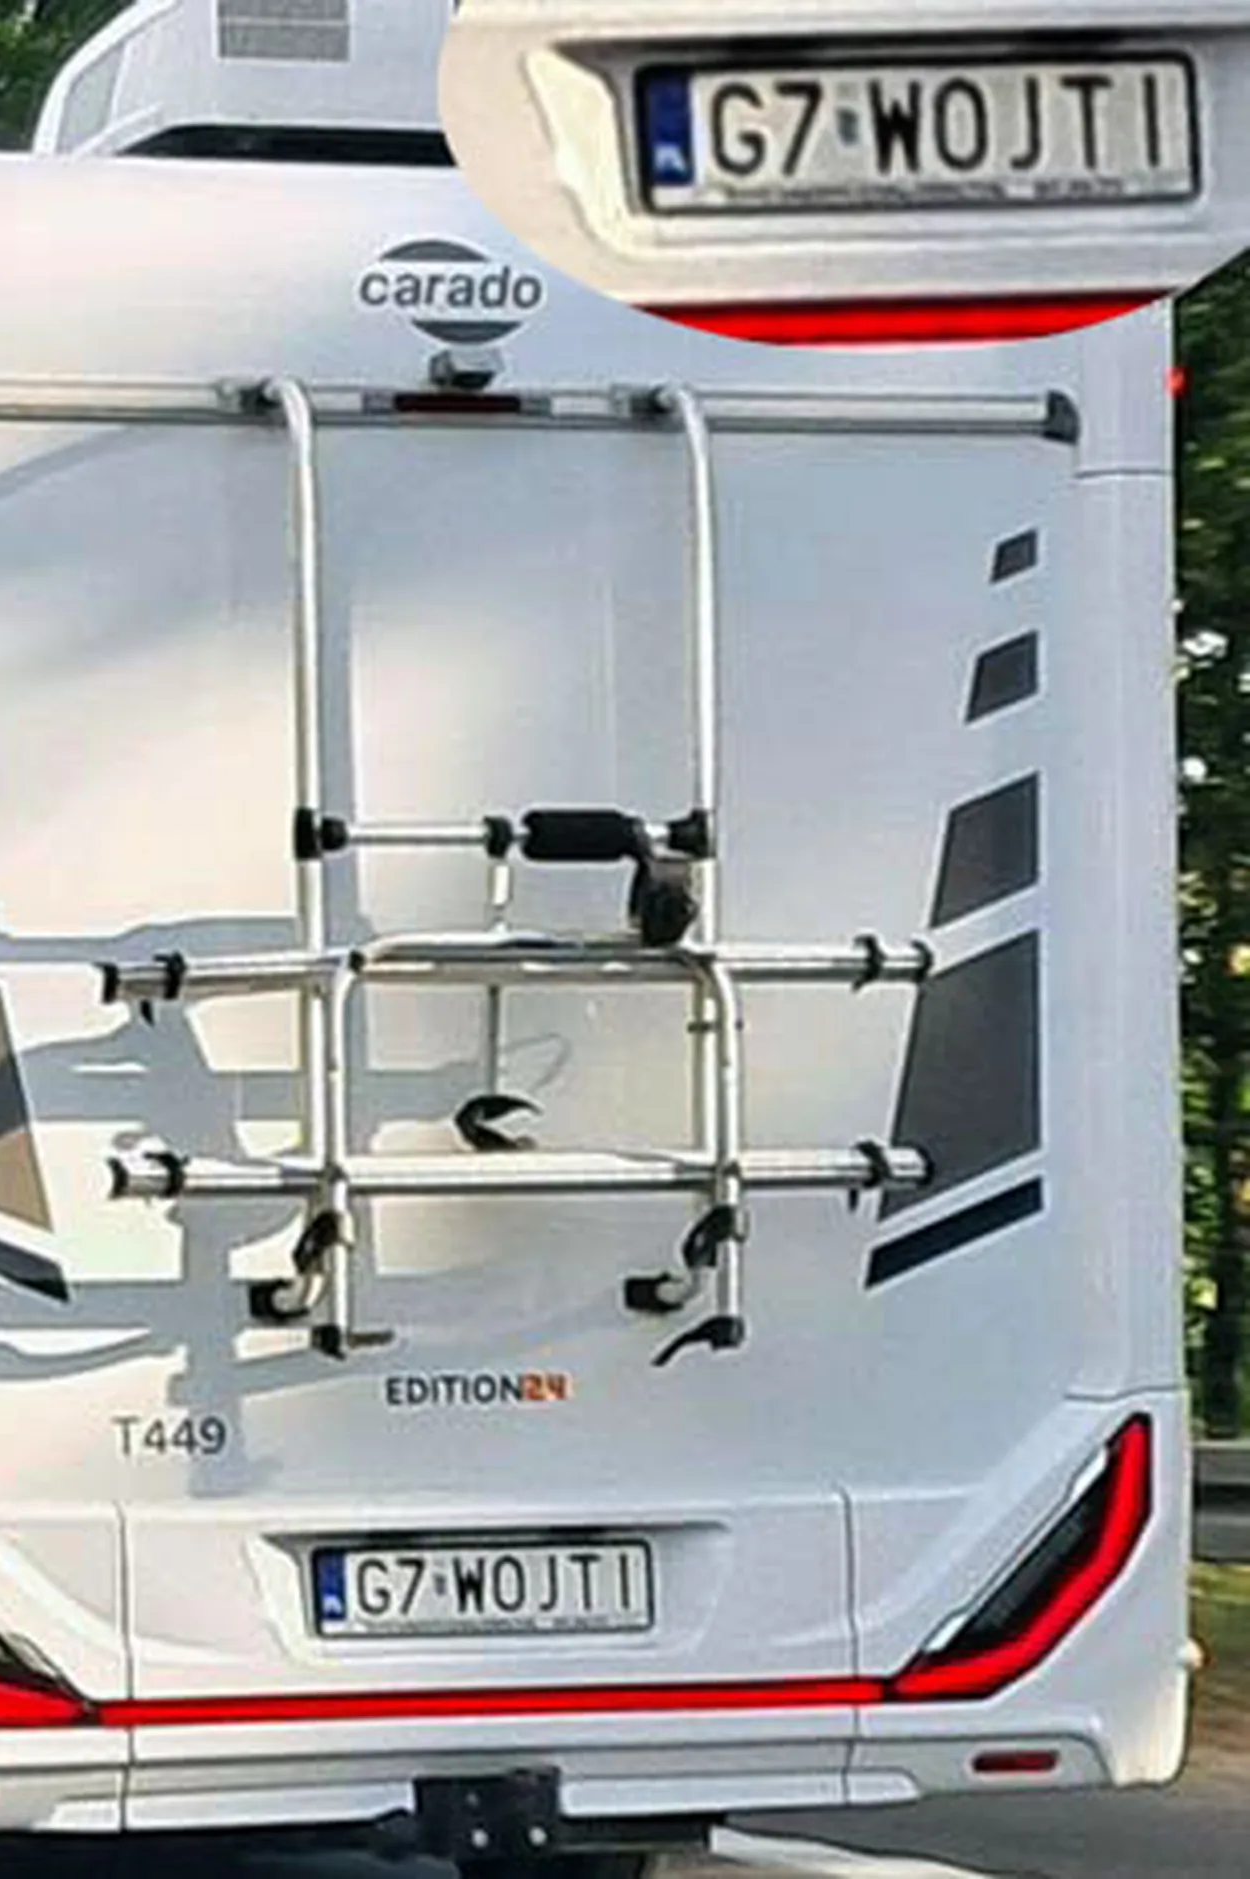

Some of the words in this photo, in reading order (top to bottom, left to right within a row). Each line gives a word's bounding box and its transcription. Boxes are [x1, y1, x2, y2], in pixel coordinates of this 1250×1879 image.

[710, 79, 823, 177] G7
[867, 73, 1160, 174] WOJTI
[359, 265, 543, 309] carado
[113, 1416, 227, 1456] T449
[356, 1558, 426, 1616] G7
[452, 1553, 631, 1614] WOJTI
